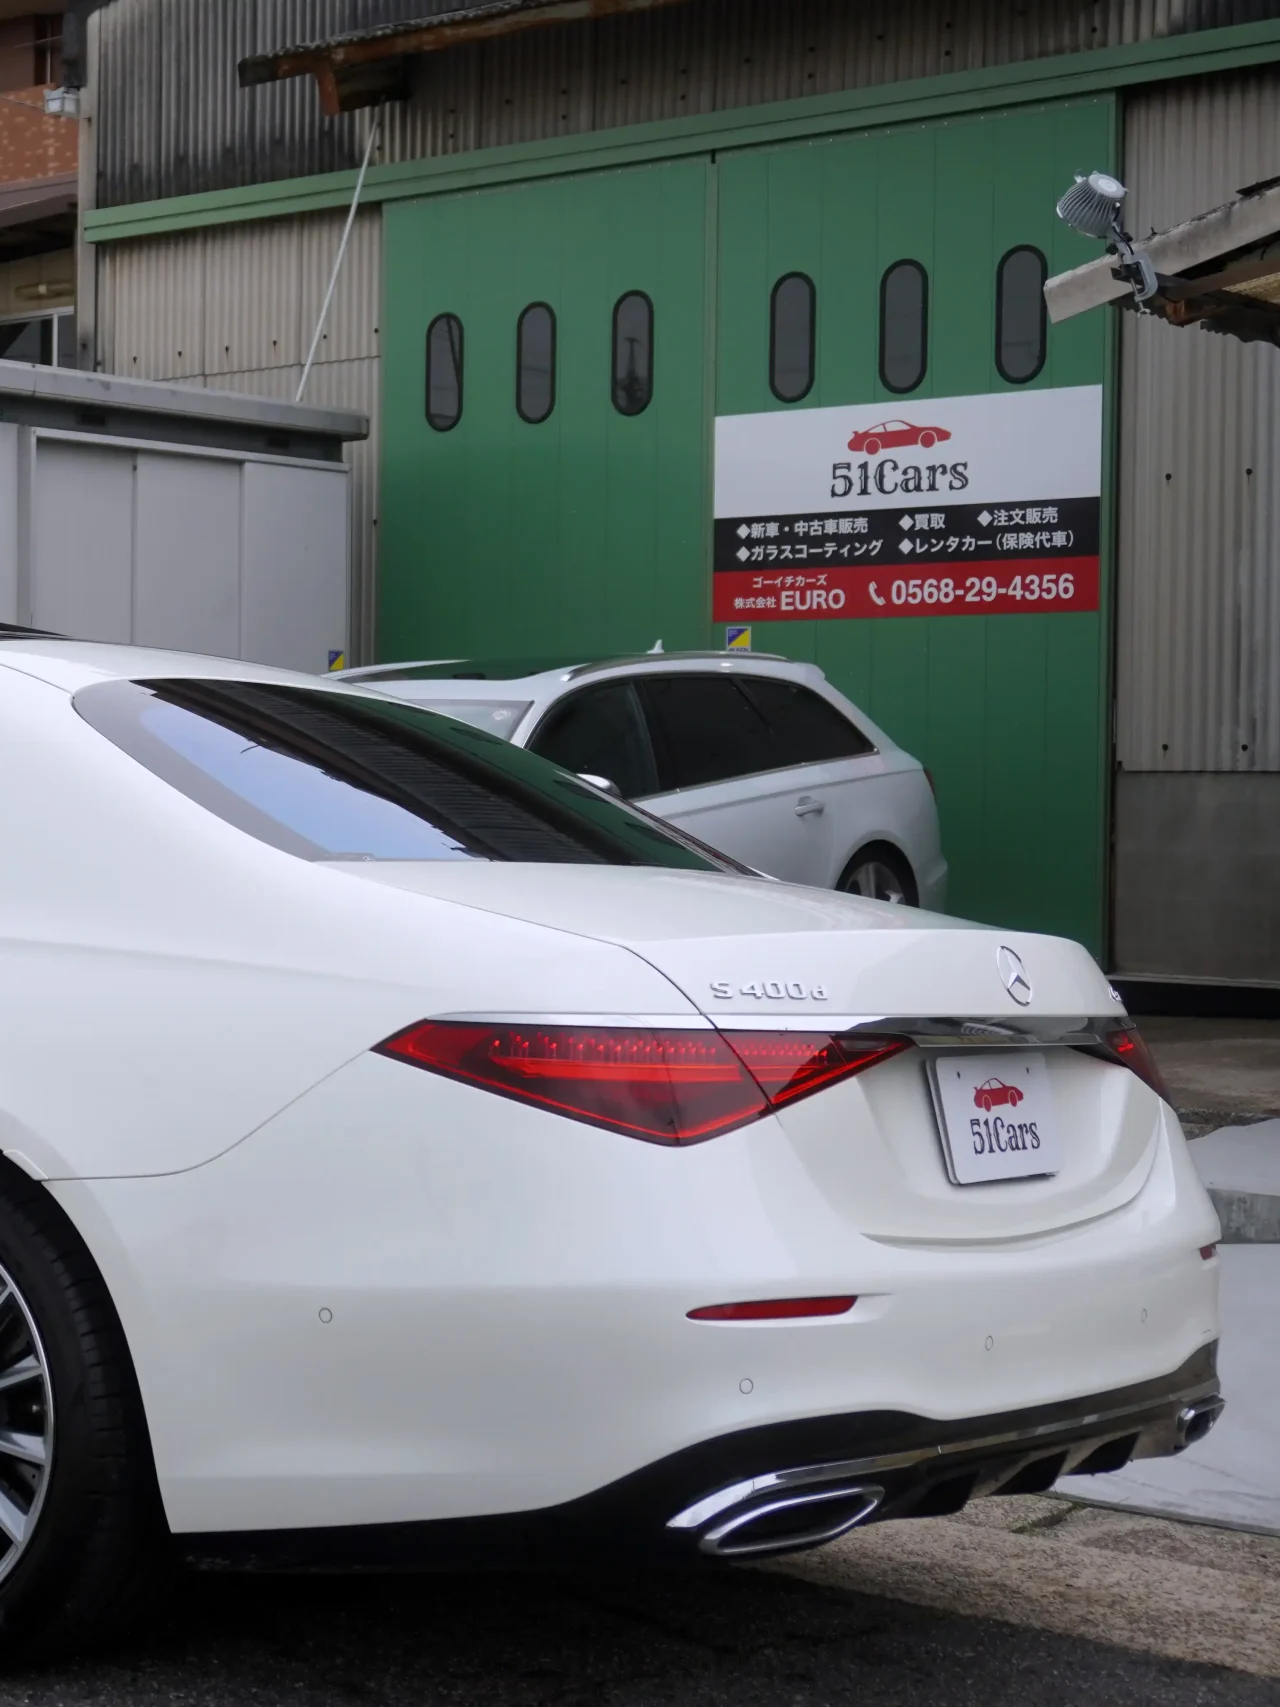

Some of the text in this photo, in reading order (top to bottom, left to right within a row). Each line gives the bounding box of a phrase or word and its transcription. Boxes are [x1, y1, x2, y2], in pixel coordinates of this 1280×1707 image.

[830, 459, 970, 499] 51Cars
[750, 516, 869, 539] 新車・中古車販売
[914, 513, 946, 531] 買取
[993, 506, 1058, 527] 注文販売
[750, 539, 883, 562] ガラスコーティング
[752, 573, 828, 589] ゴーイチカーズ
[891, 572, 1075, 605] 0568-29-4356
[734, 588, 846, 611] 株式会社 EURO
[970, 1116, 1041, 1155] 51Cars
